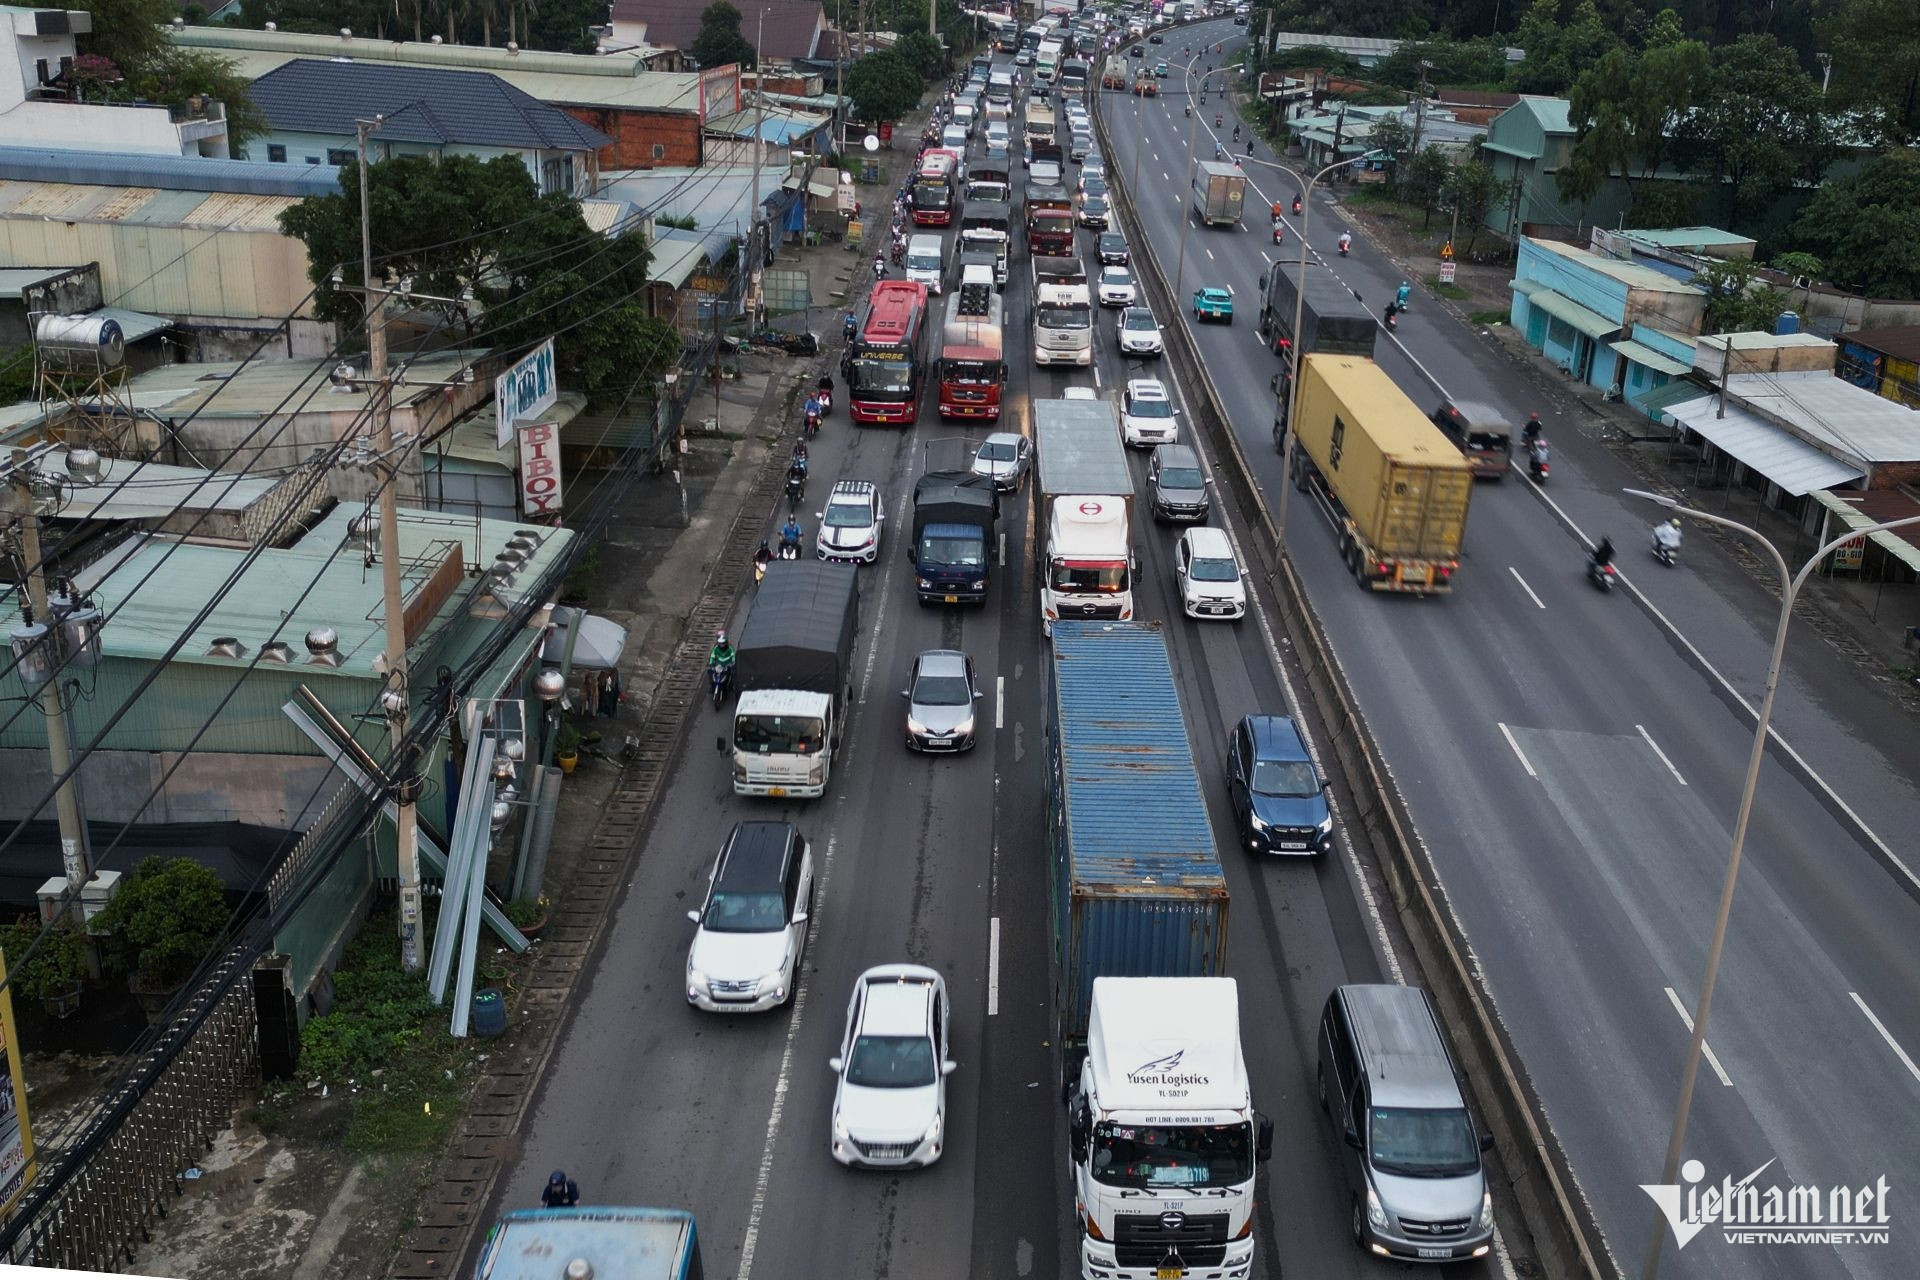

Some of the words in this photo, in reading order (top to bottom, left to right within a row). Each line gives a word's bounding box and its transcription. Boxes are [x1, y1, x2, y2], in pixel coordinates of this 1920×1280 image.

[860, 352, 905, 360] UNIVERSE
[524, 424, 557, 514] BIBOY
[1127, 1073, 1159, 1084] Yusen
[1161, 1073, 1209, 1087] Logistics
